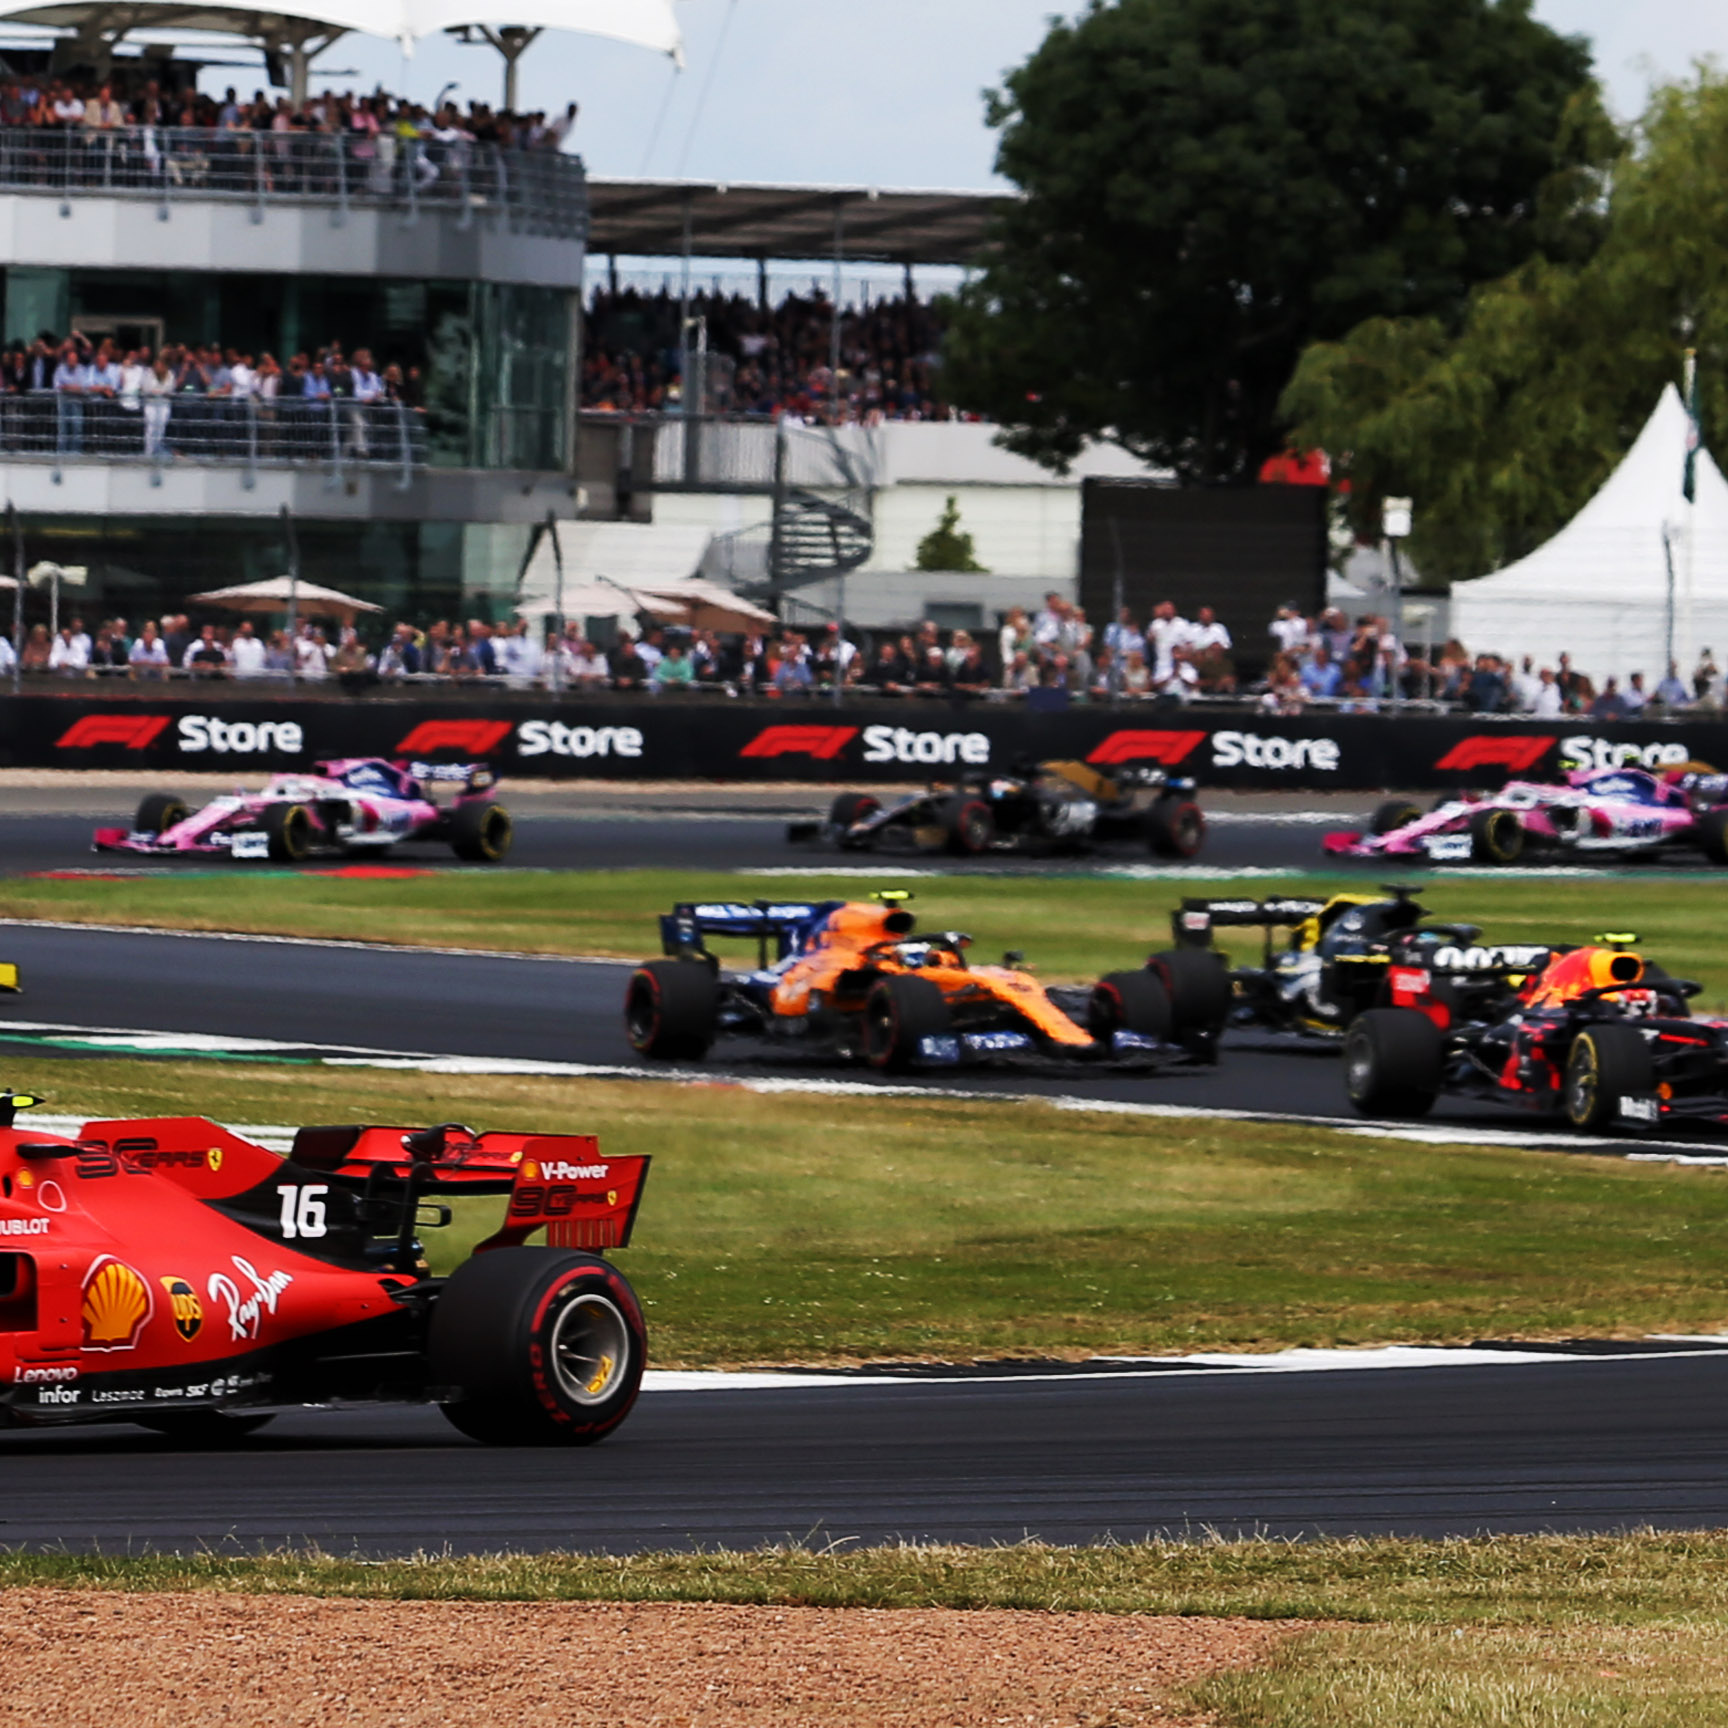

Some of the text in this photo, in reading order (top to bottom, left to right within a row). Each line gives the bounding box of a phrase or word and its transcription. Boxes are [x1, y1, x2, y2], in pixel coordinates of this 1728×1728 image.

[178, 716, 303, 753] Store
[518, 721, 643, 758] Store
[863, 726, 990, 764] Store
[1212, 731, 1340, 771] Store
[540, 1161, 610, 1180] V-Power
[276, 1184, 329, 1239] 16
[13, 1366, 78, 1383] Lenovo
[38, 1385, 81, 1404] infor
